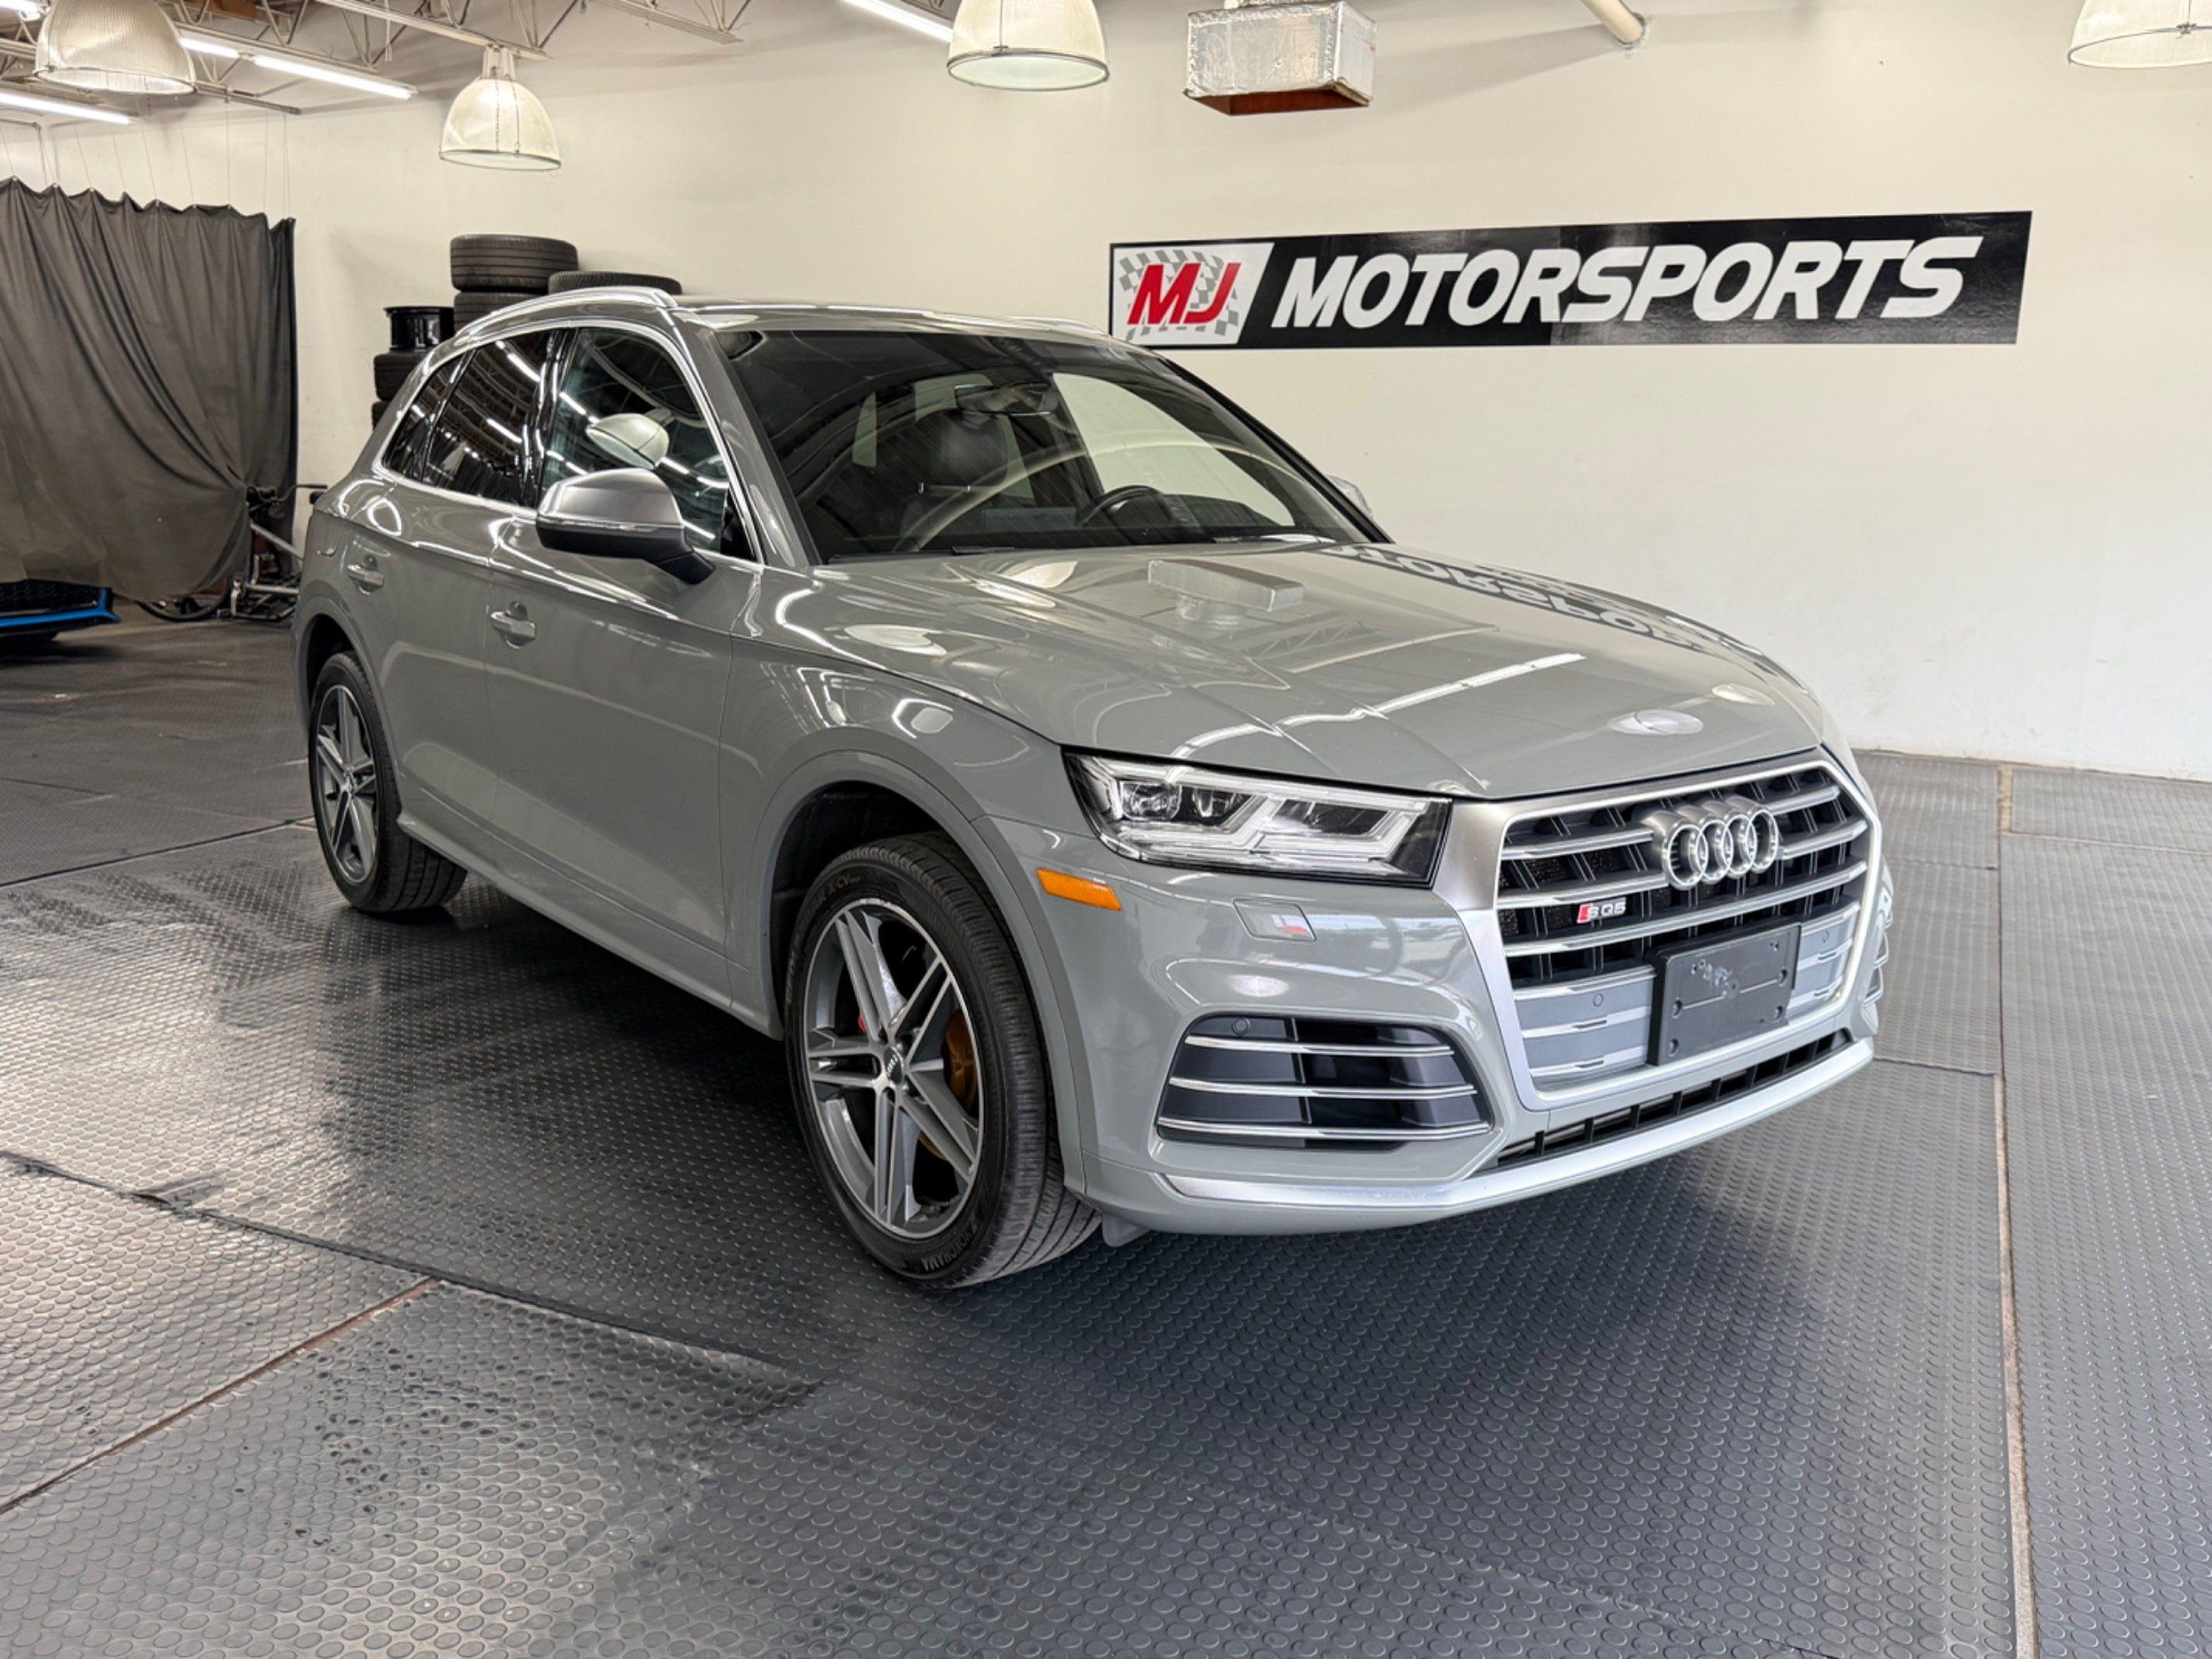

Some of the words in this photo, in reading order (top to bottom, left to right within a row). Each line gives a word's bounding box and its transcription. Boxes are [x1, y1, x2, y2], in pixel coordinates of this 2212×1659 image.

[1126, 262, 1242, 326] MJ
[1271, 235, 1984, 328] MOTORSPORTS
[1584, 898, 1626, 921] SQ5
